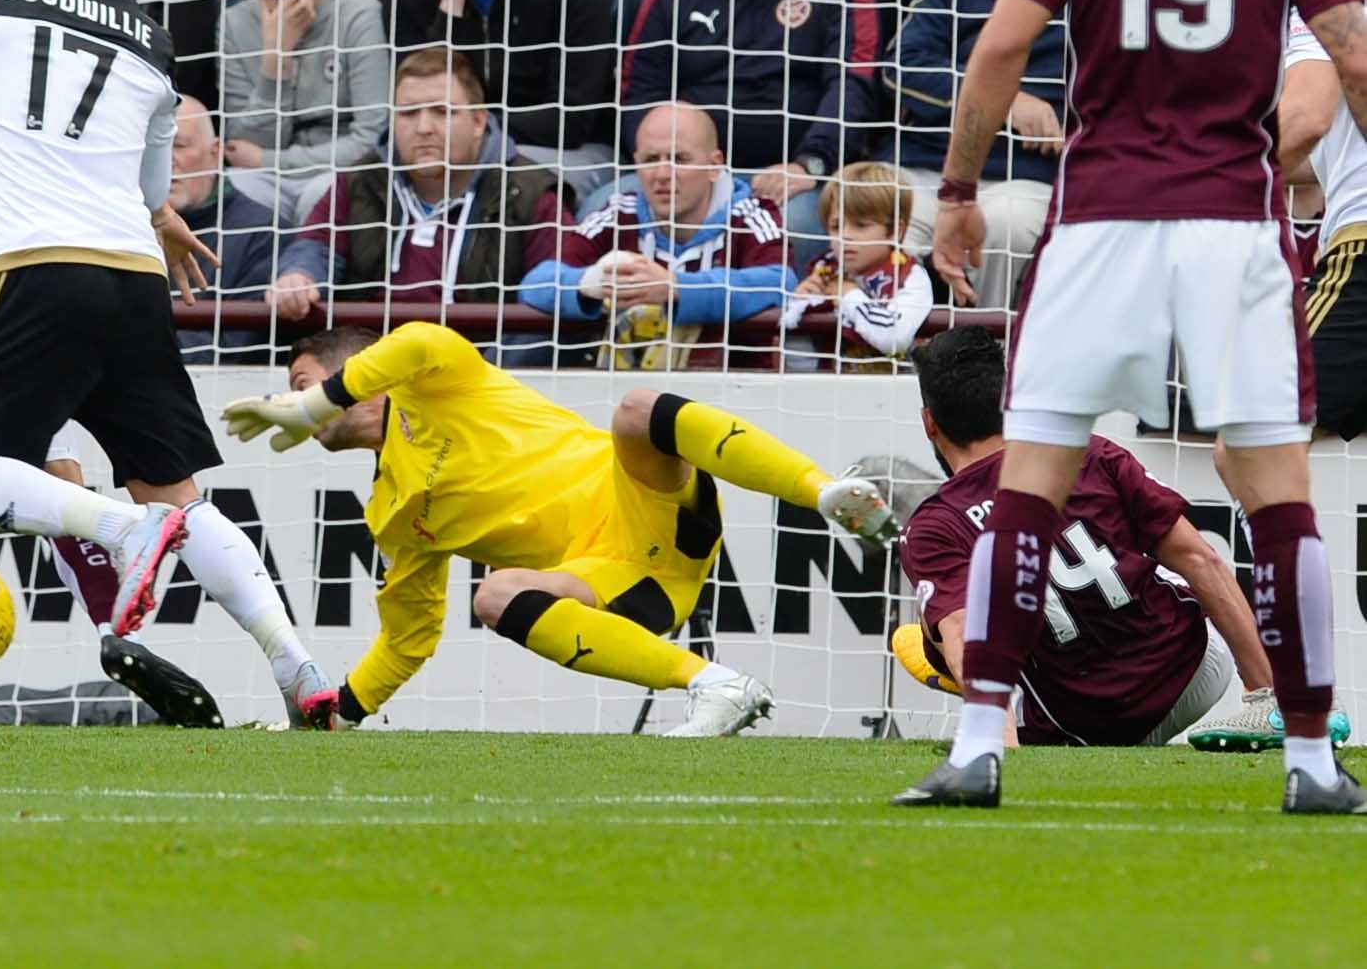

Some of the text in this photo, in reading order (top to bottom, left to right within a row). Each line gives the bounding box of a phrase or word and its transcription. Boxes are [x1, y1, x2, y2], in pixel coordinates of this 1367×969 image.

[26, 25, 119, 141] 17
[1014, 531, 1041, 612] HMFC
[1253, 562, 1284, 647] HMFC
